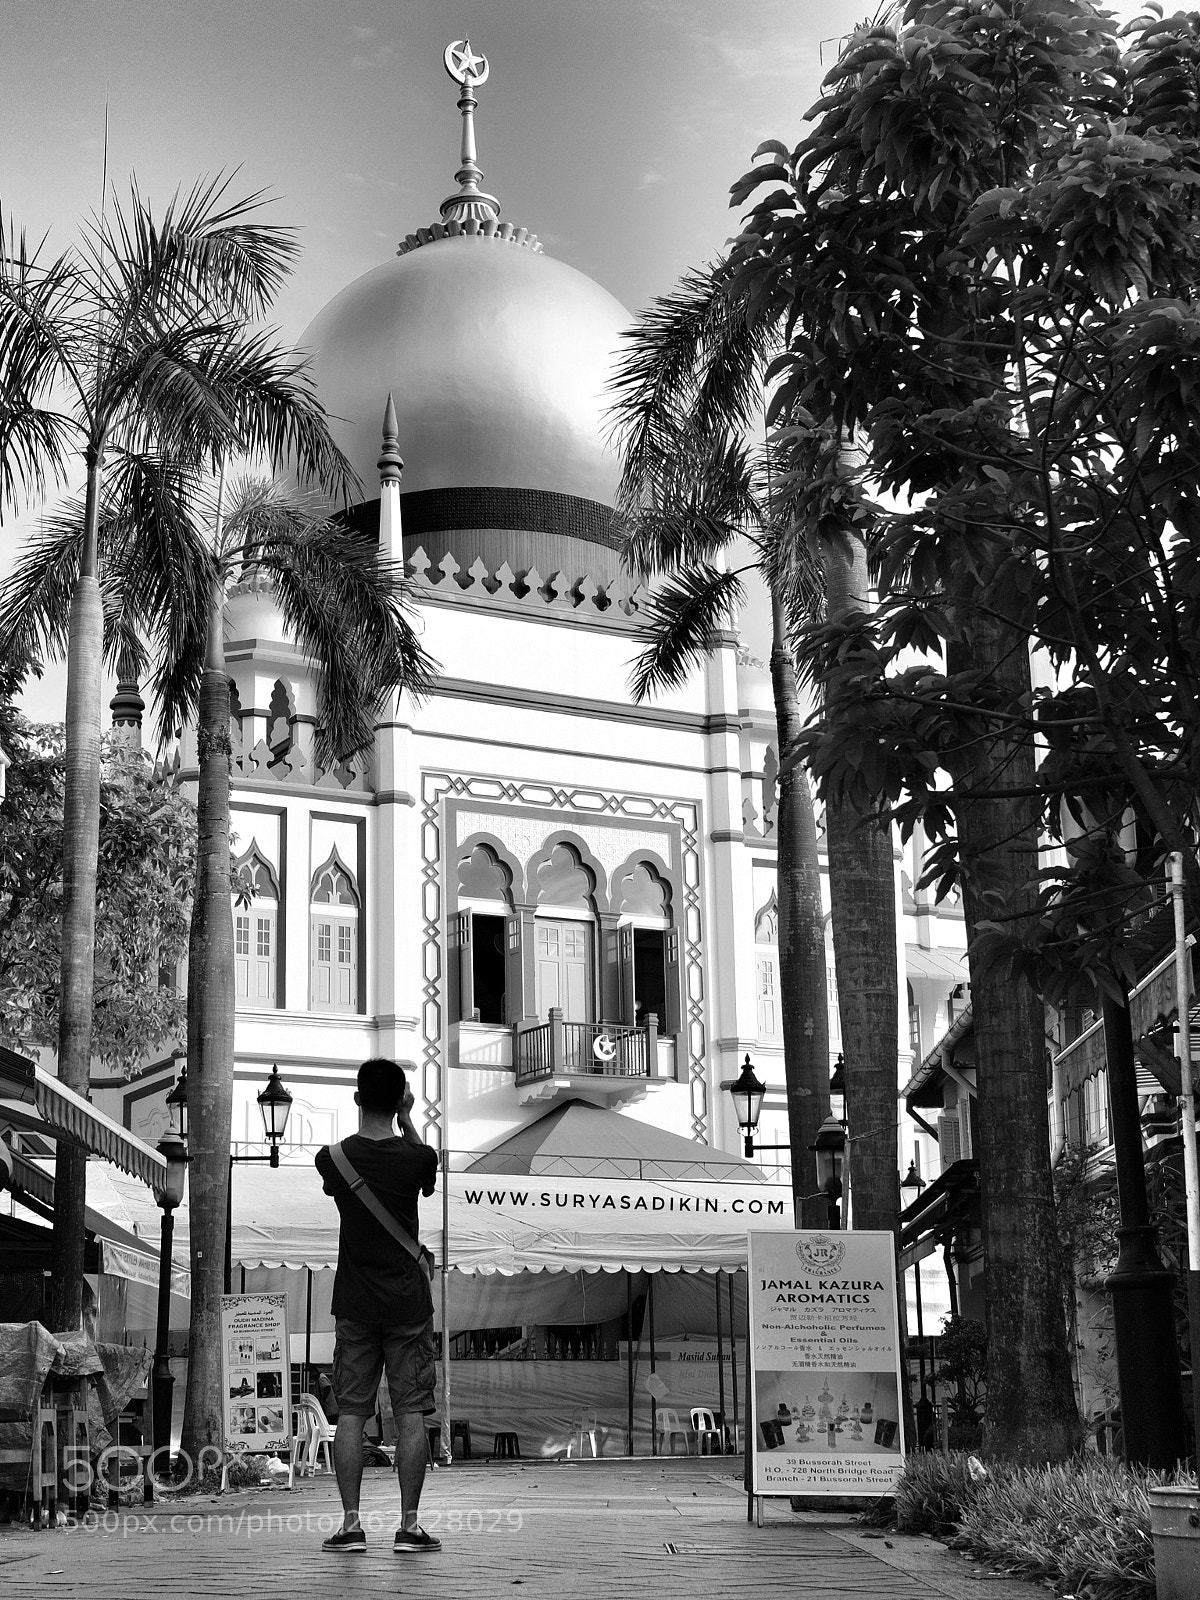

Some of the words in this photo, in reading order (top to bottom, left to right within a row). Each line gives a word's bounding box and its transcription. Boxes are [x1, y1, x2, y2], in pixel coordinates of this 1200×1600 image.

[813, 1248, 829, 1258] JR
[760, 1279, 813, 1291] JAMAL
[818, 1280, 885, 1291] KAZURA
[775, 1293, 871, 1304] AROMATICS
[761, 1323, 837, 1331] Non-Alchoholic
[678, 1351, 705, 1361] Masjid
